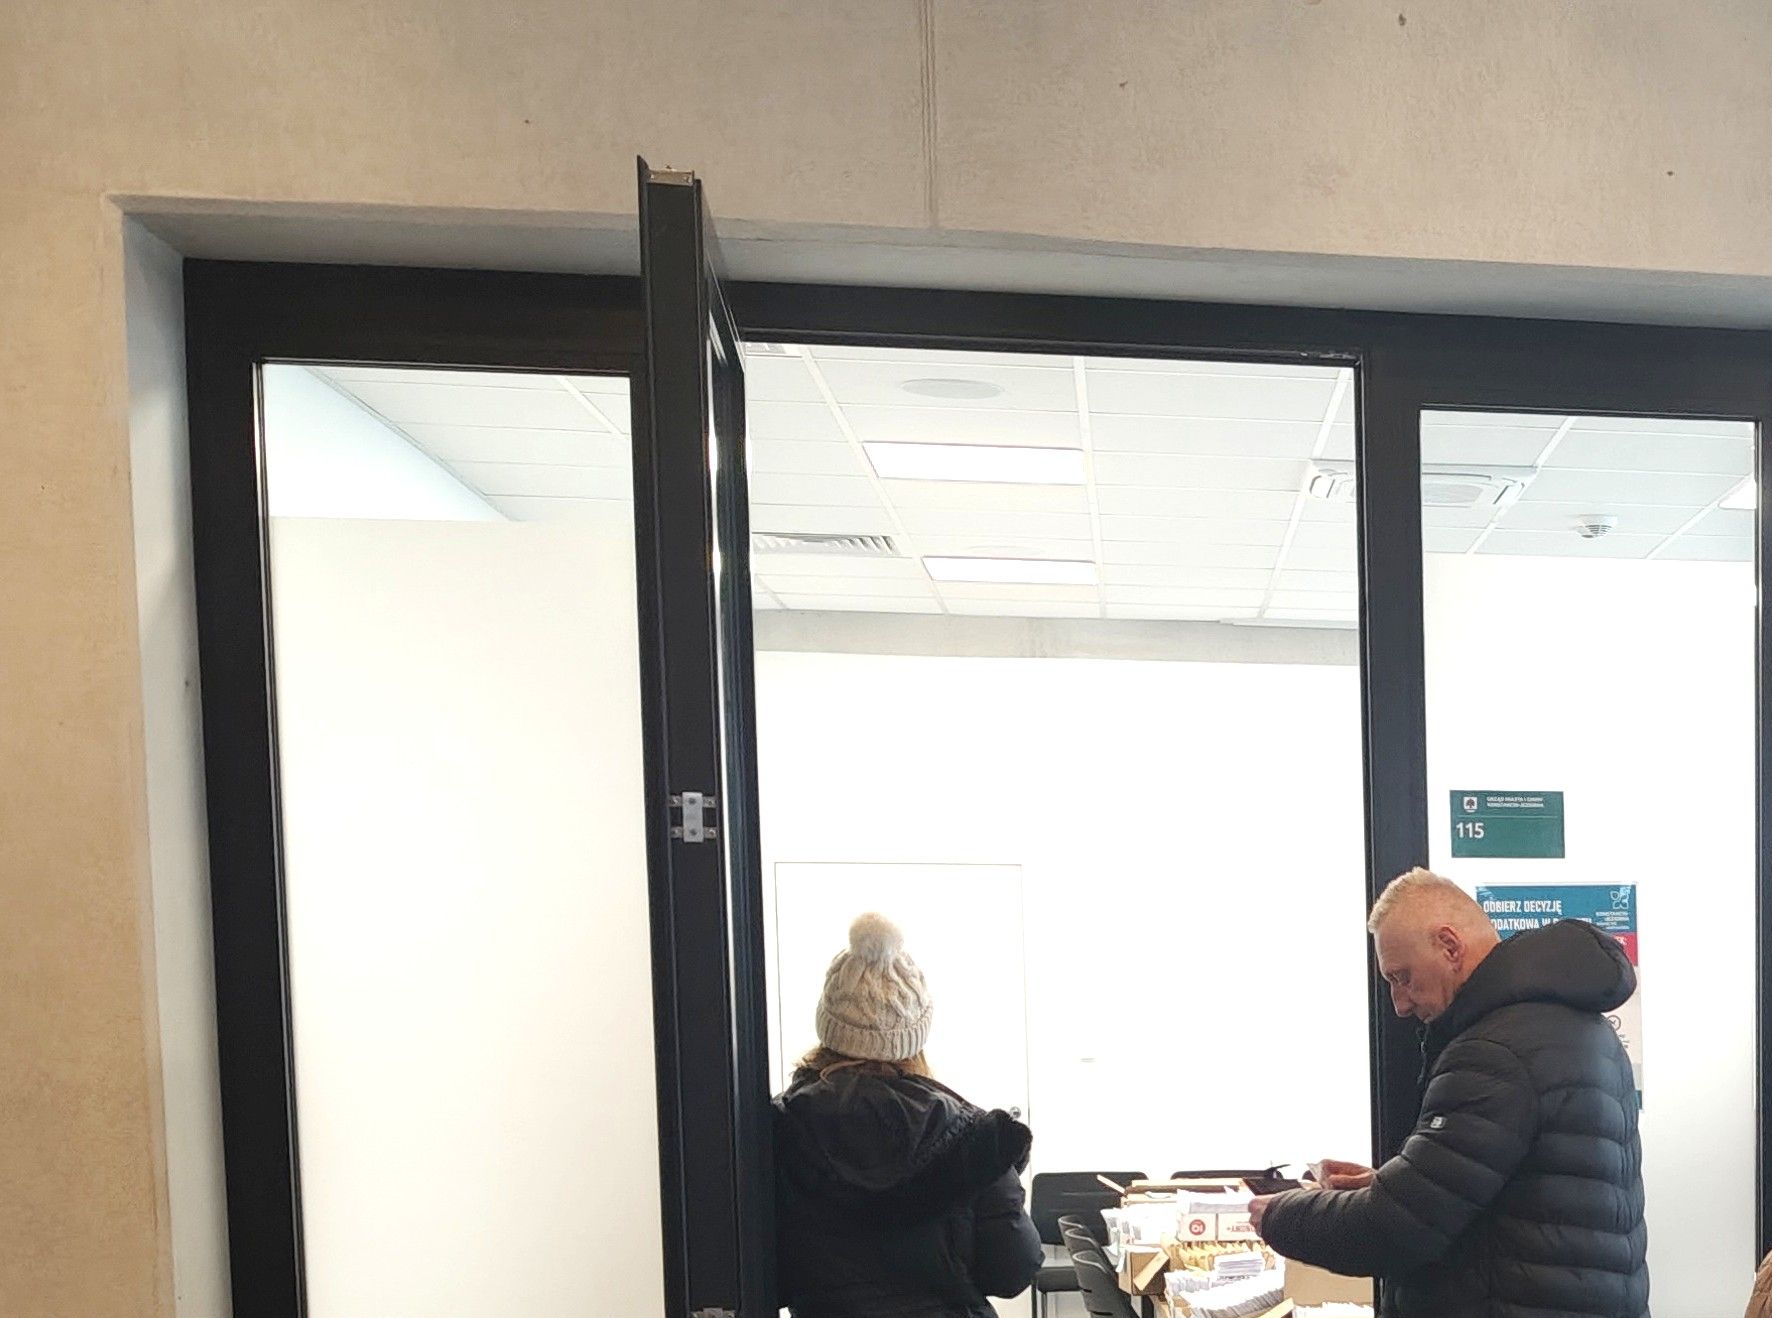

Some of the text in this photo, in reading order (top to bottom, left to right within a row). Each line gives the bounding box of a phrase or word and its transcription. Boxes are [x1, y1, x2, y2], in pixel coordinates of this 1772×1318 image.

[1456, 822, 1485, 839] 115
[1483, 900, 1563, 915] ODBIERZ DECYZJĘ
